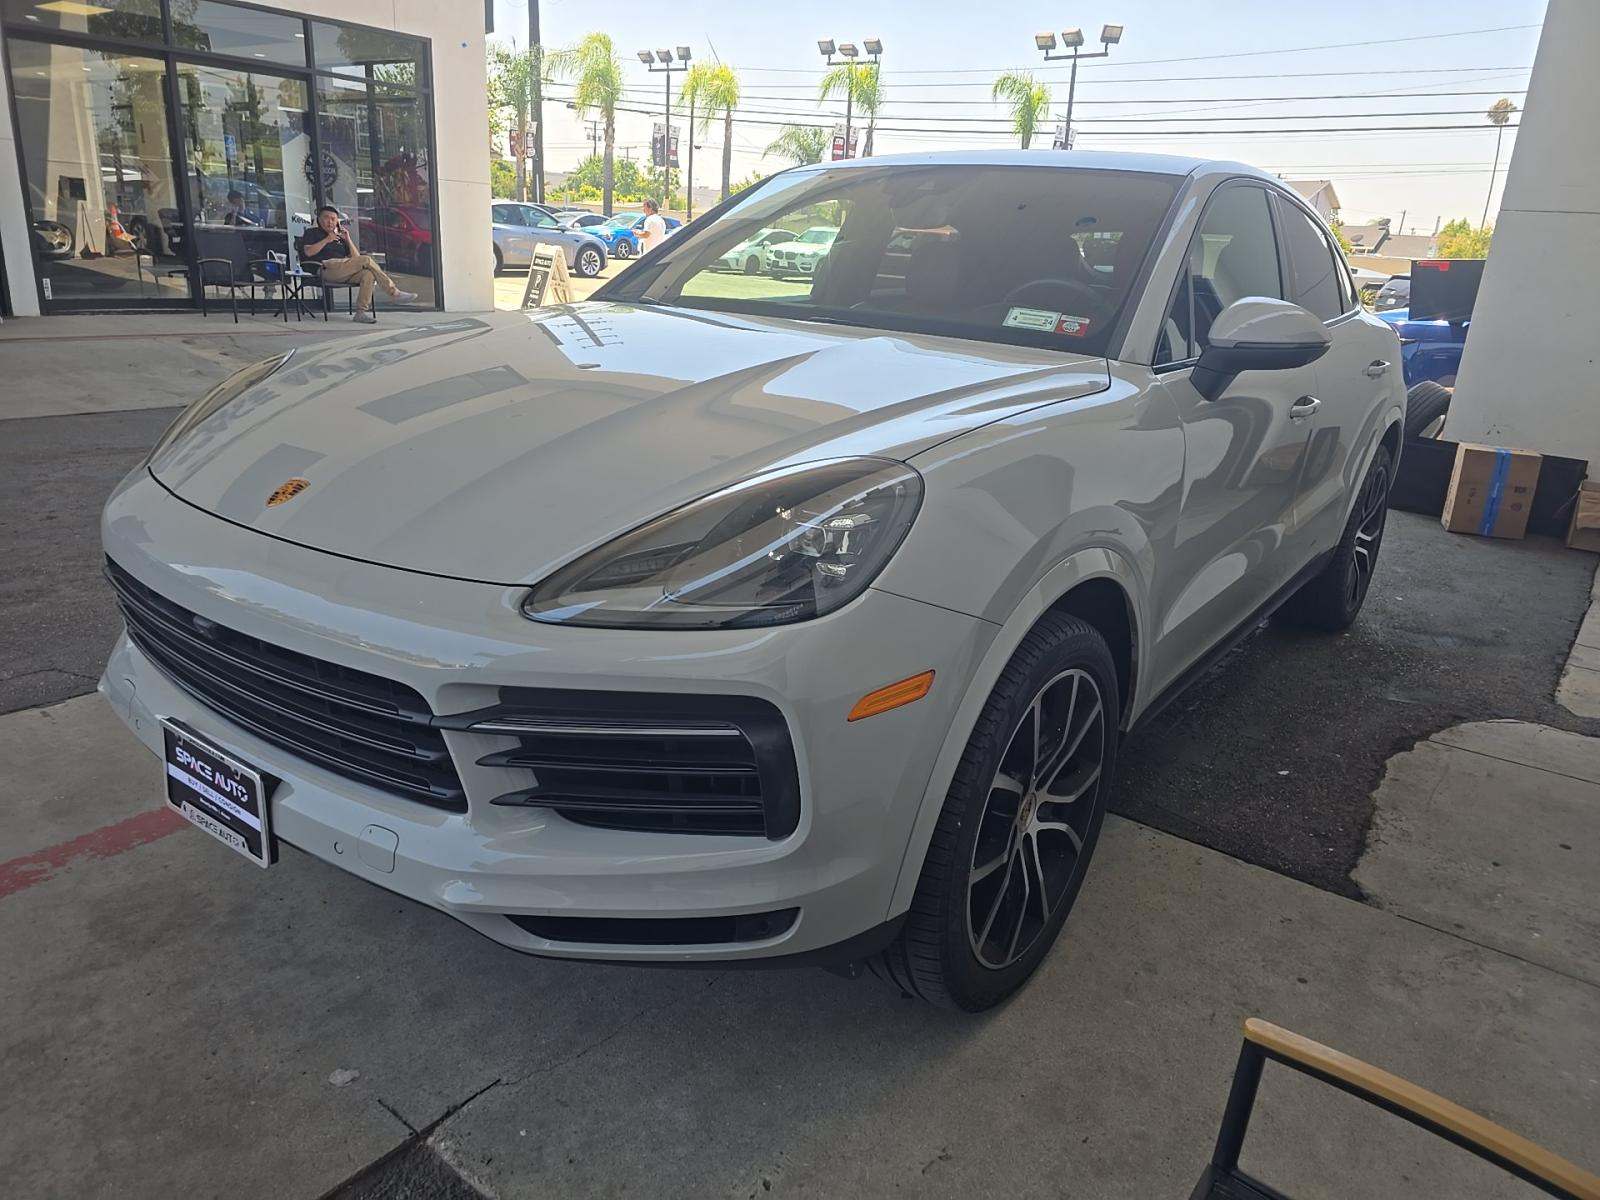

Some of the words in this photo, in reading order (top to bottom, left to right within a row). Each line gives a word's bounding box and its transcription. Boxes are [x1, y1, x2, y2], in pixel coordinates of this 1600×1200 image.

[175, 746, 213, 781] SPACE
[214, 771, 248, 802] AUTO
[195, 814, 217, 833] SPACE
